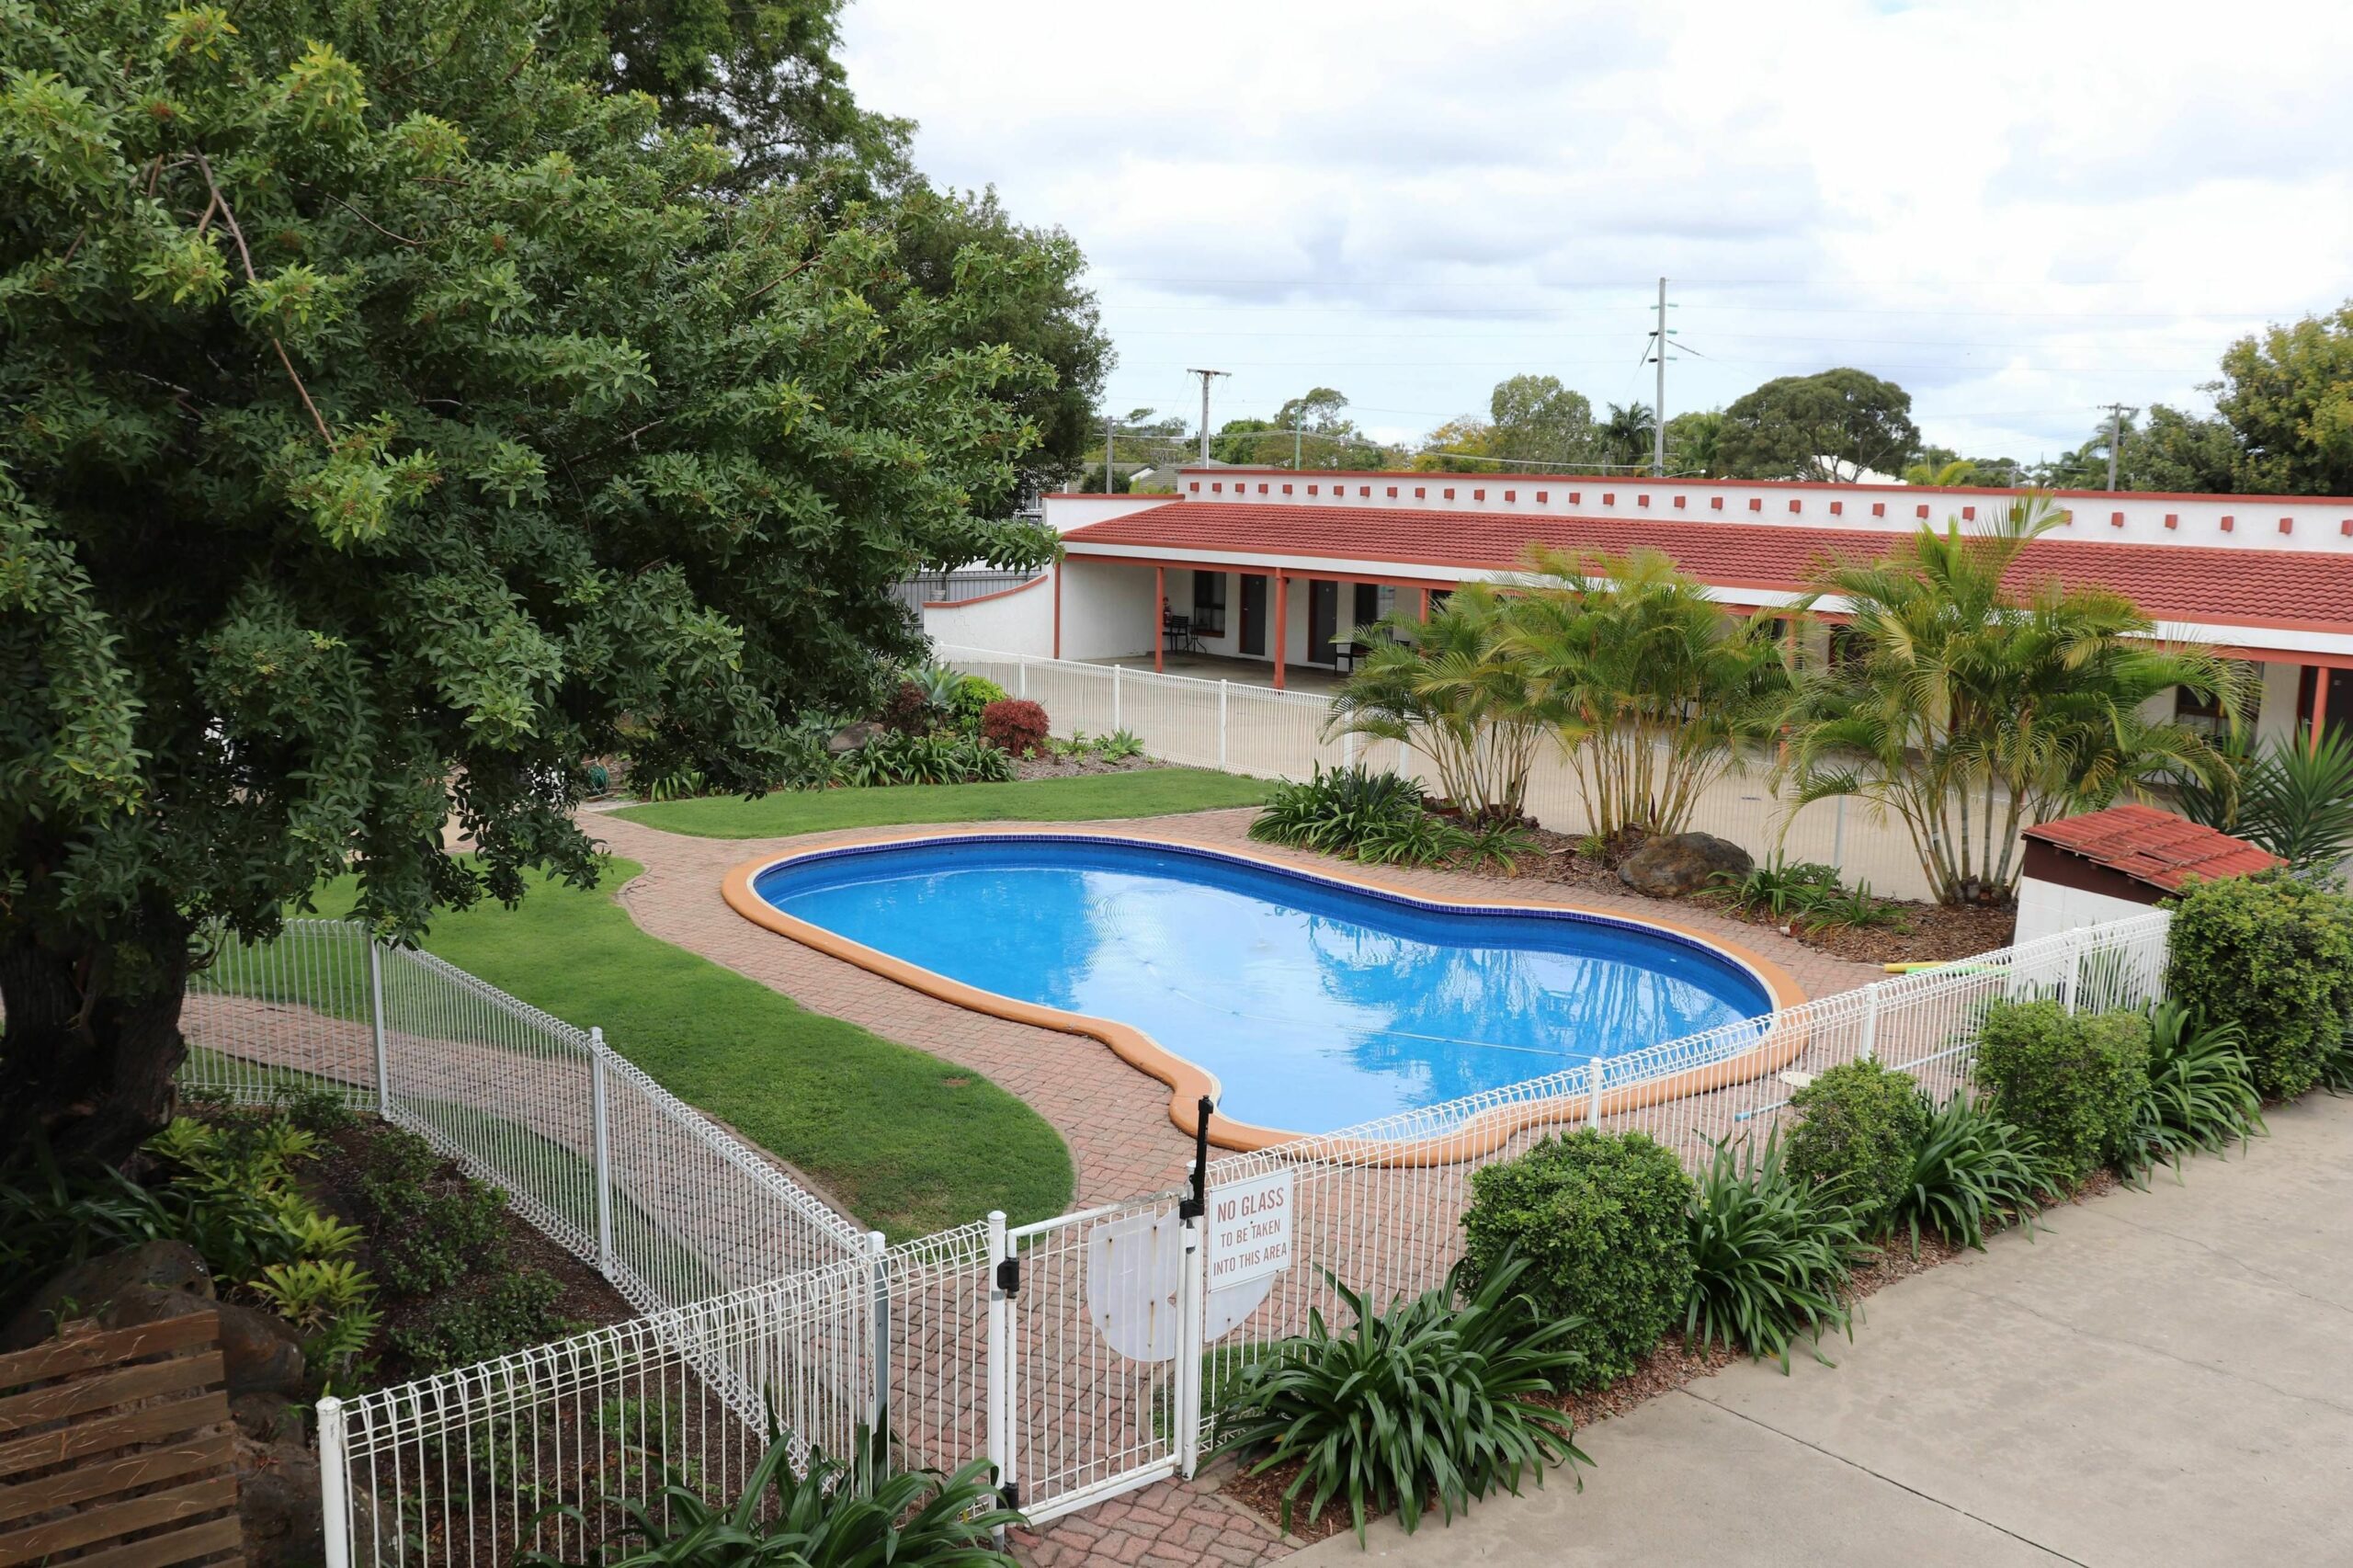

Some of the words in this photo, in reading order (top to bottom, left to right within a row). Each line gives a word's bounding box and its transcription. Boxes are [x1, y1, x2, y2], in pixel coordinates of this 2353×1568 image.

[1217, 1199, 1236, 1223] NO
[1241, 1187, 1284, 1217] GLASS
[1221, 1232, 1233, 1248] TO
[1236, 1227, 1248, 1244] BE
[1251, 1218, 1280, 1239] TAKEN
[1213, 1256, 1235, 1277] INTO
[1239, 1250, 1260, 1268] THIS
[1263, 1242, 1287, 1262] AREA
